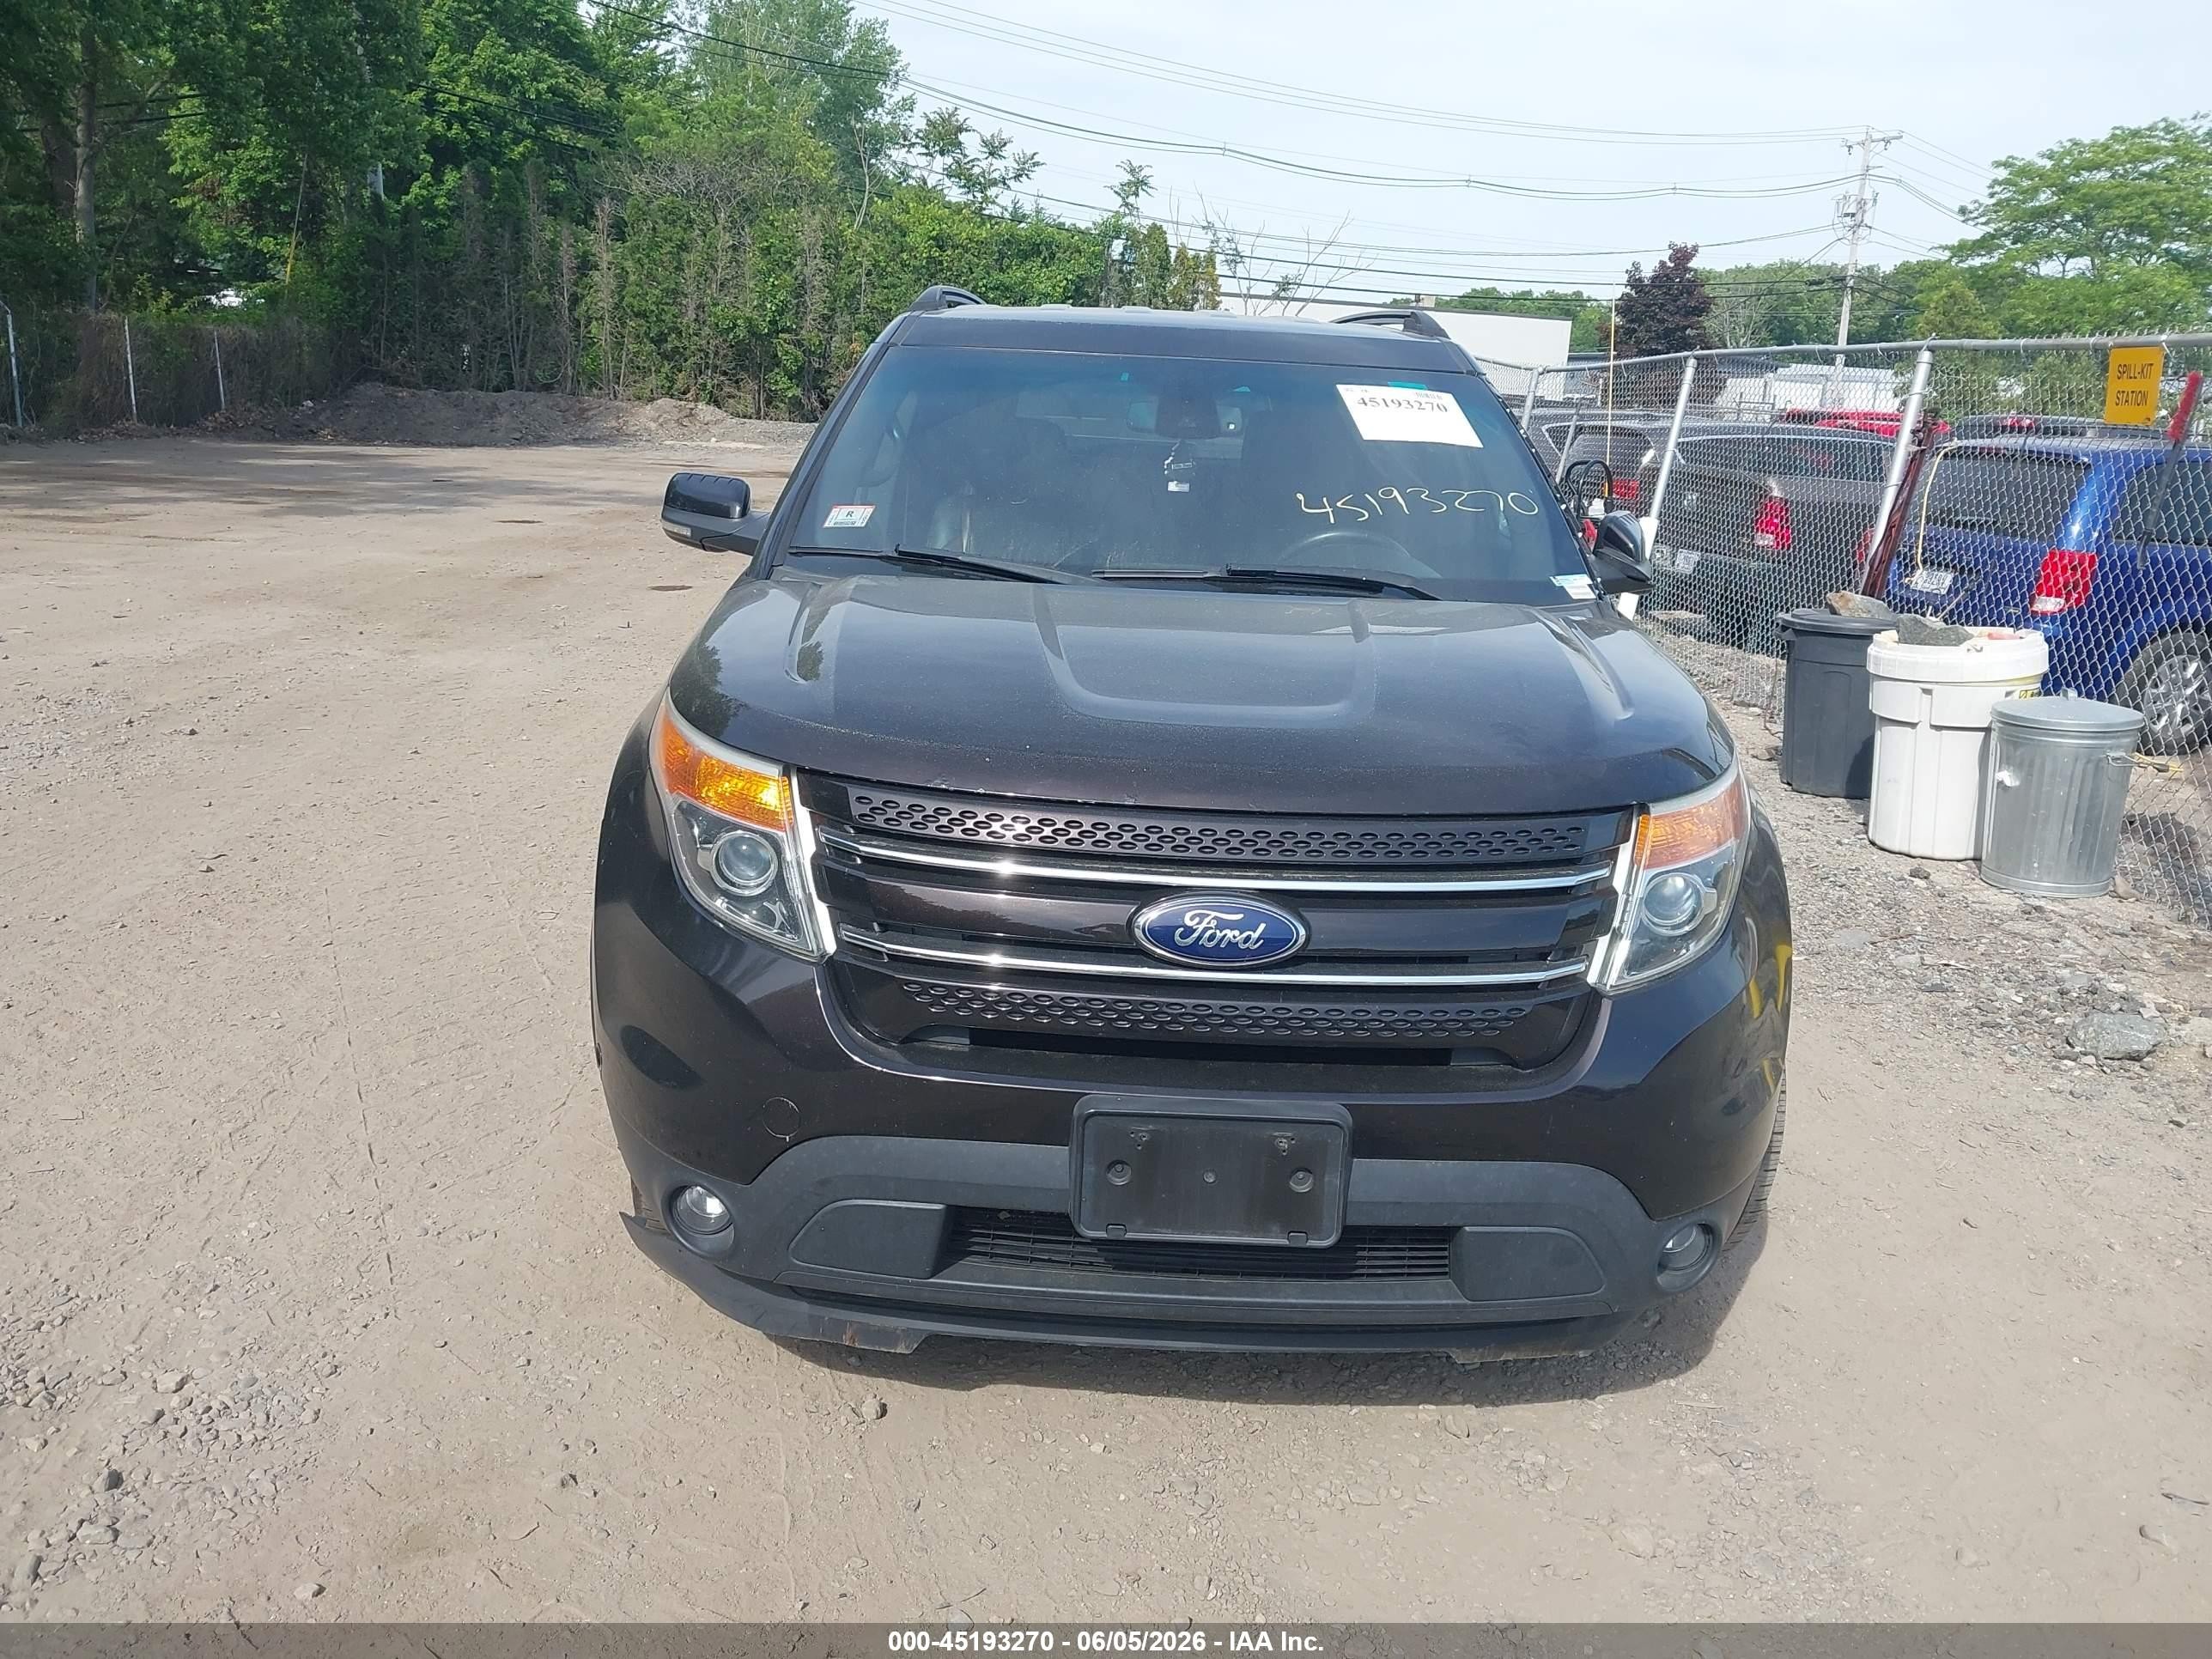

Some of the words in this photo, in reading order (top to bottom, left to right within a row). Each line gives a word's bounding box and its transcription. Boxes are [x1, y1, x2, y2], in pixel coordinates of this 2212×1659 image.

[2117, 362, 2154, 380] SPILL-KIT
[1357, 397, 1448, 413] 45193270
[2115, 390, 2149, 407] STATION
[1294, 486, 1539, 524] 45193270
[1174, 908, 1267, 950] Ford
